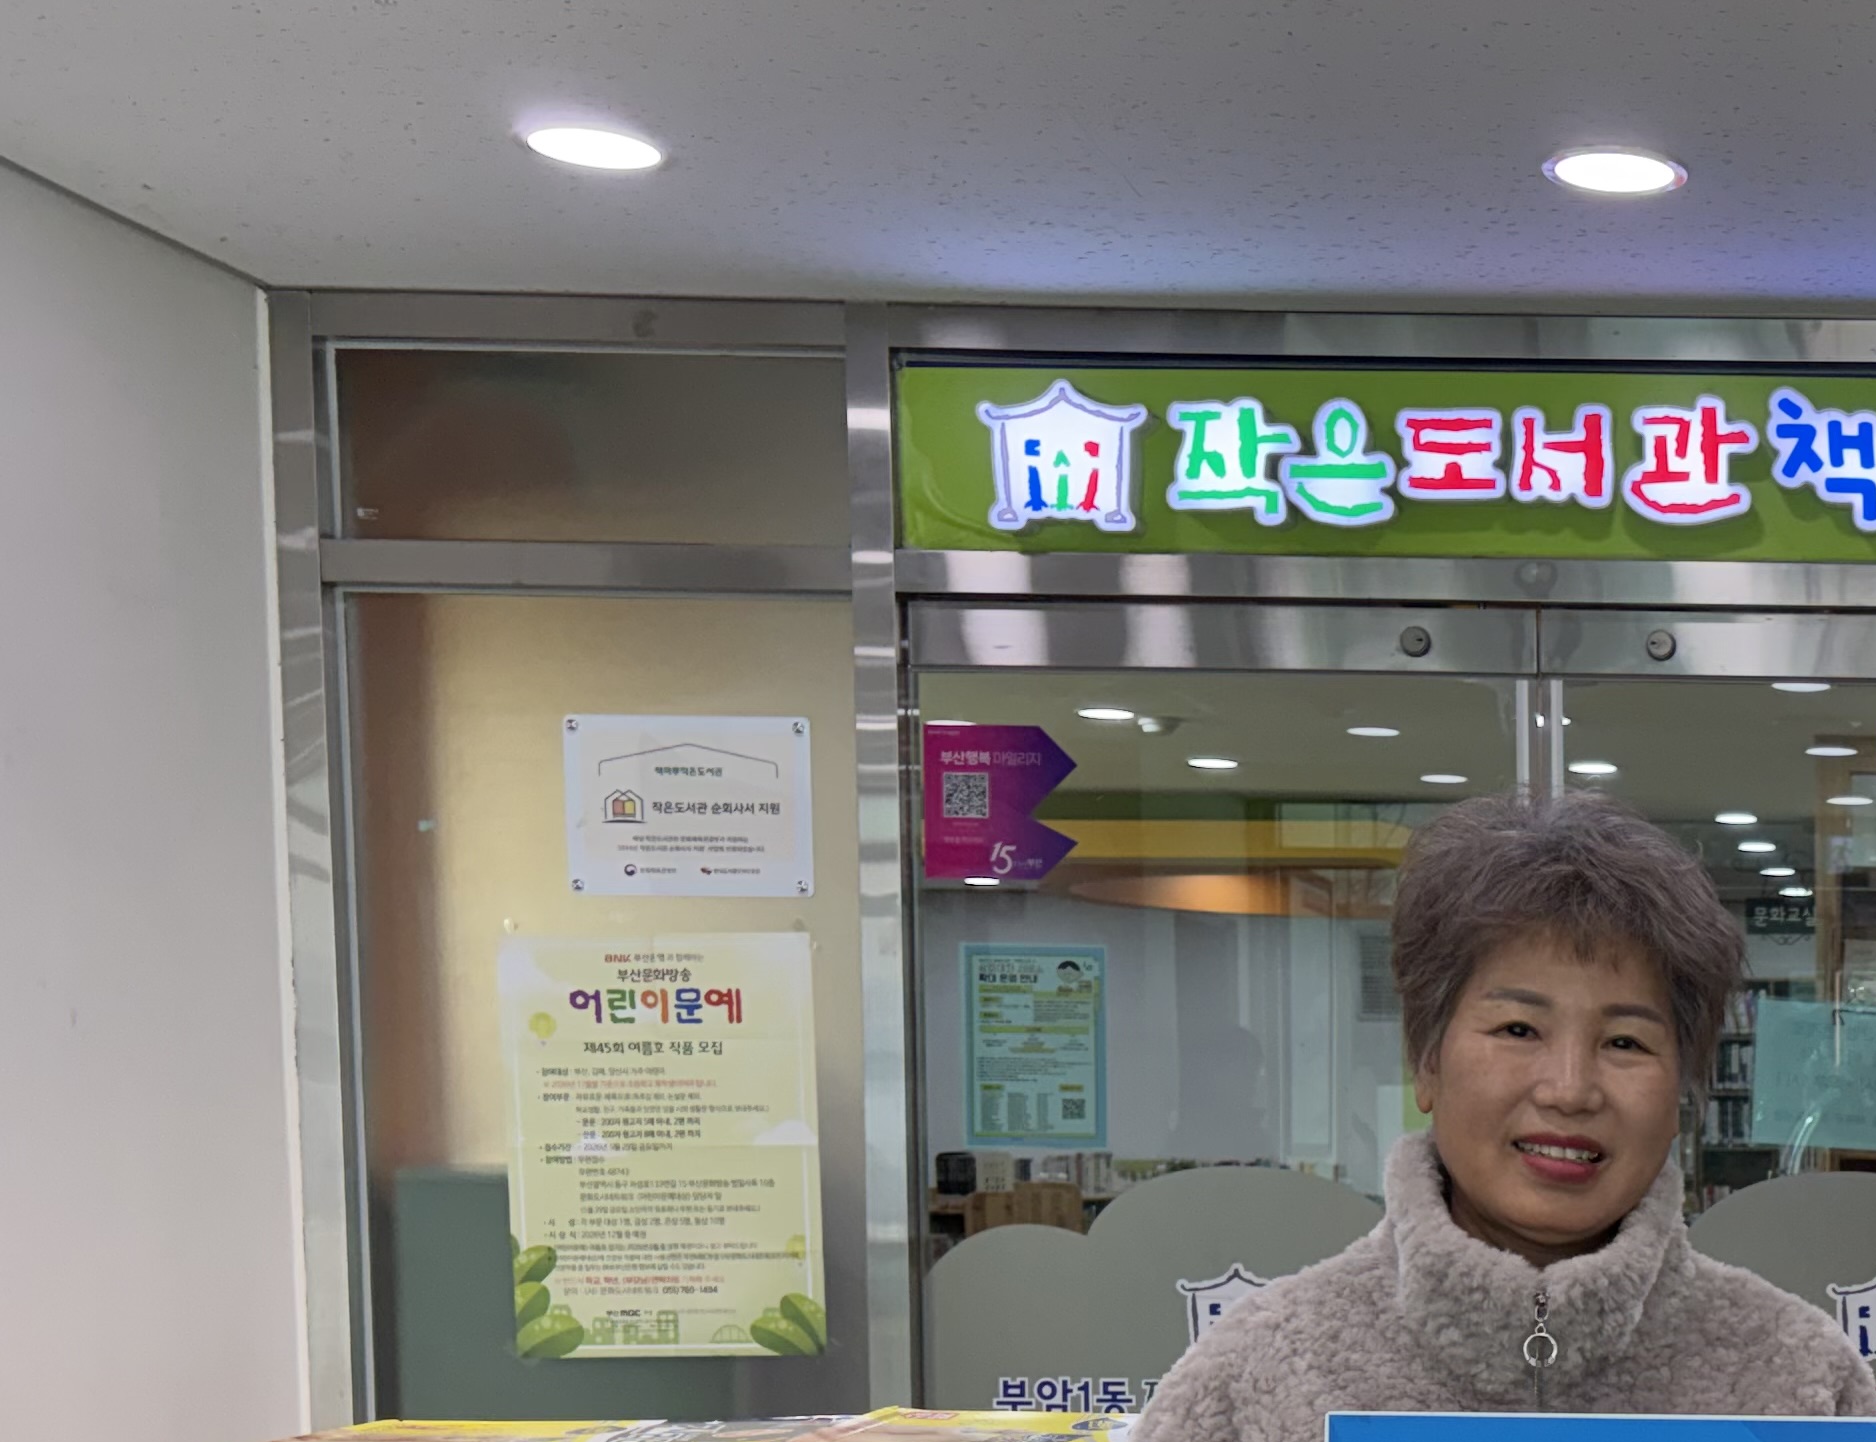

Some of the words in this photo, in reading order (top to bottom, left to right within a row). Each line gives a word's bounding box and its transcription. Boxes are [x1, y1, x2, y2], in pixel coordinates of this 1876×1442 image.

[941, 751, 992, 765] 부산행복
[652, 802, 707, 815] 작은도서관
[712, 803, 754, 814] 순회사서
[759, 802, 780, 815] 지원
[990, 841, 1016, 874] 15
[617, 968, 692, 982] 부산문화방송
[569, 988, 742, 1024] 어린이문예
[584, 1042, 625, 1055] 제45회
[628, 1042, 664, 1055] 여름호
[669, 1042, 693, 1055] 작품
[698, 1042, 723, 1055] 모집
